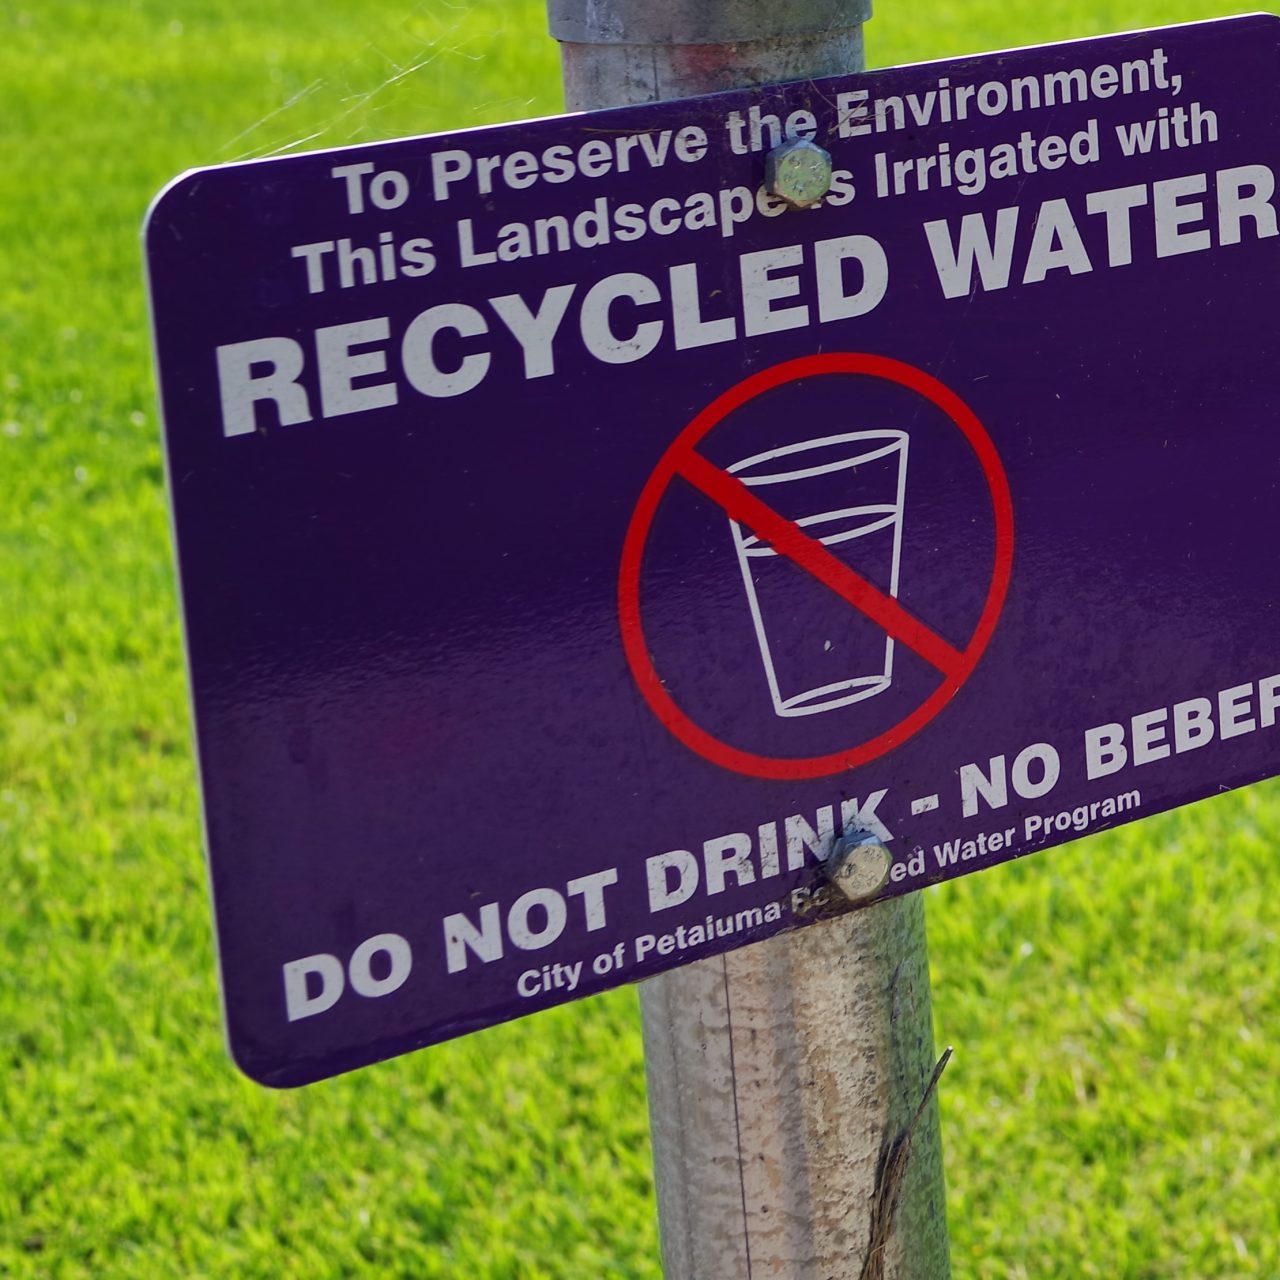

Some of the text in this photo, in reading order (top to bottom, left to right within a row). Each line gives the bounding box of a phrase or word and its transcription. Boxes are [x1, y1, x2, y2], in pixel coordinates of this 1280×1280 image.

[292, 231, 437, 294] This
[458, 183, 788, 268] Landscape
[874, 120, 1100, 198] Irrigated
[1115, 102, 1218, 156] with
[332, 48, 1182, 214] To Preserve the Environment,
[216, 164, 1280, 437] RECYCLED WATER
[283, 932, 412, 1021] DO
[443, 868, 618, 974] NOT
[645, 788, 894, 914] DRINK
[911, 794, 939, 815] -
[960, 743, 1061, 818] NO
[517, 960, 583, 998] City
[592, 942, 625, 975] of
[635, 901, 781, 963] Petaluma
[933, 829, 1014, 867] Water
[1025, 789, 1141, 841] Program
